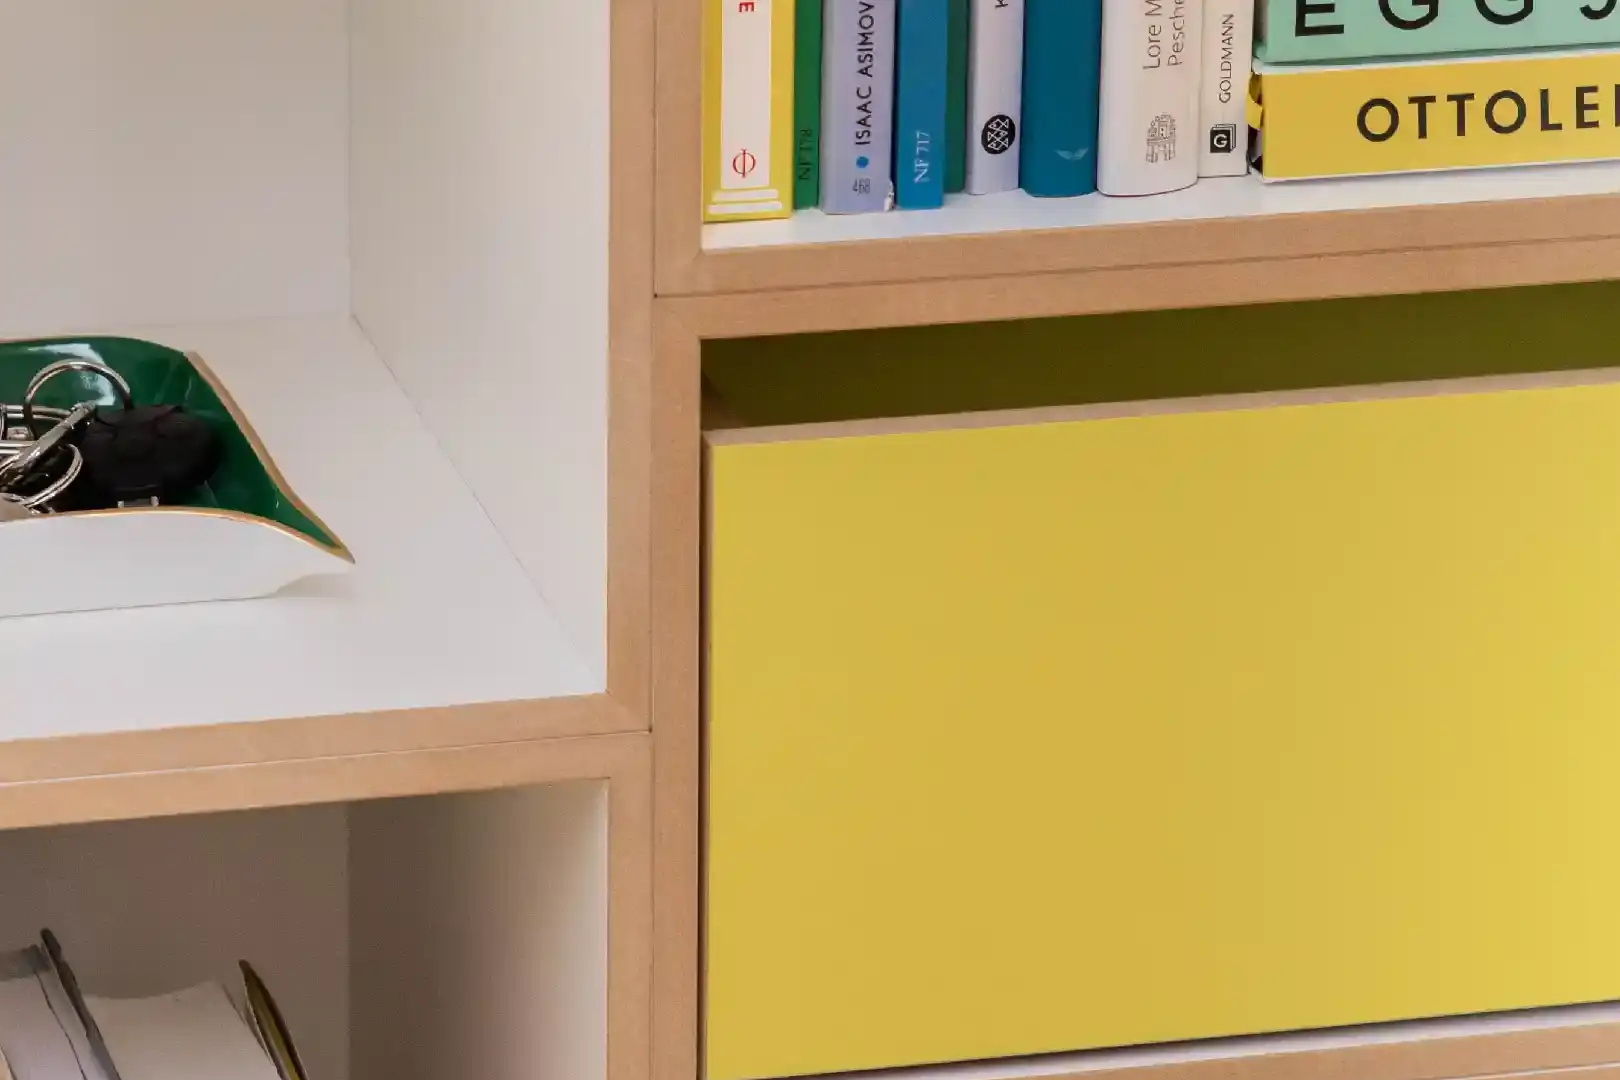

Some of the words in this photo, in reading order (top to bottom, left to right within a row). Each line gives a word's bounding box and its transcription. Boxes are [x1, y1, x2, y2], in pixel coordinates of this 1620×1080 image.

[857, 1, 875, 78] ASIMOV
[1142, 24, 1162, 70] Lore
[1218, 13, 1235, 104] GOLDMANN
[855, 85, 872, 145] ISAAC
[916, 130, 930, 154] 717
[914, 158, 930, 183] NF
